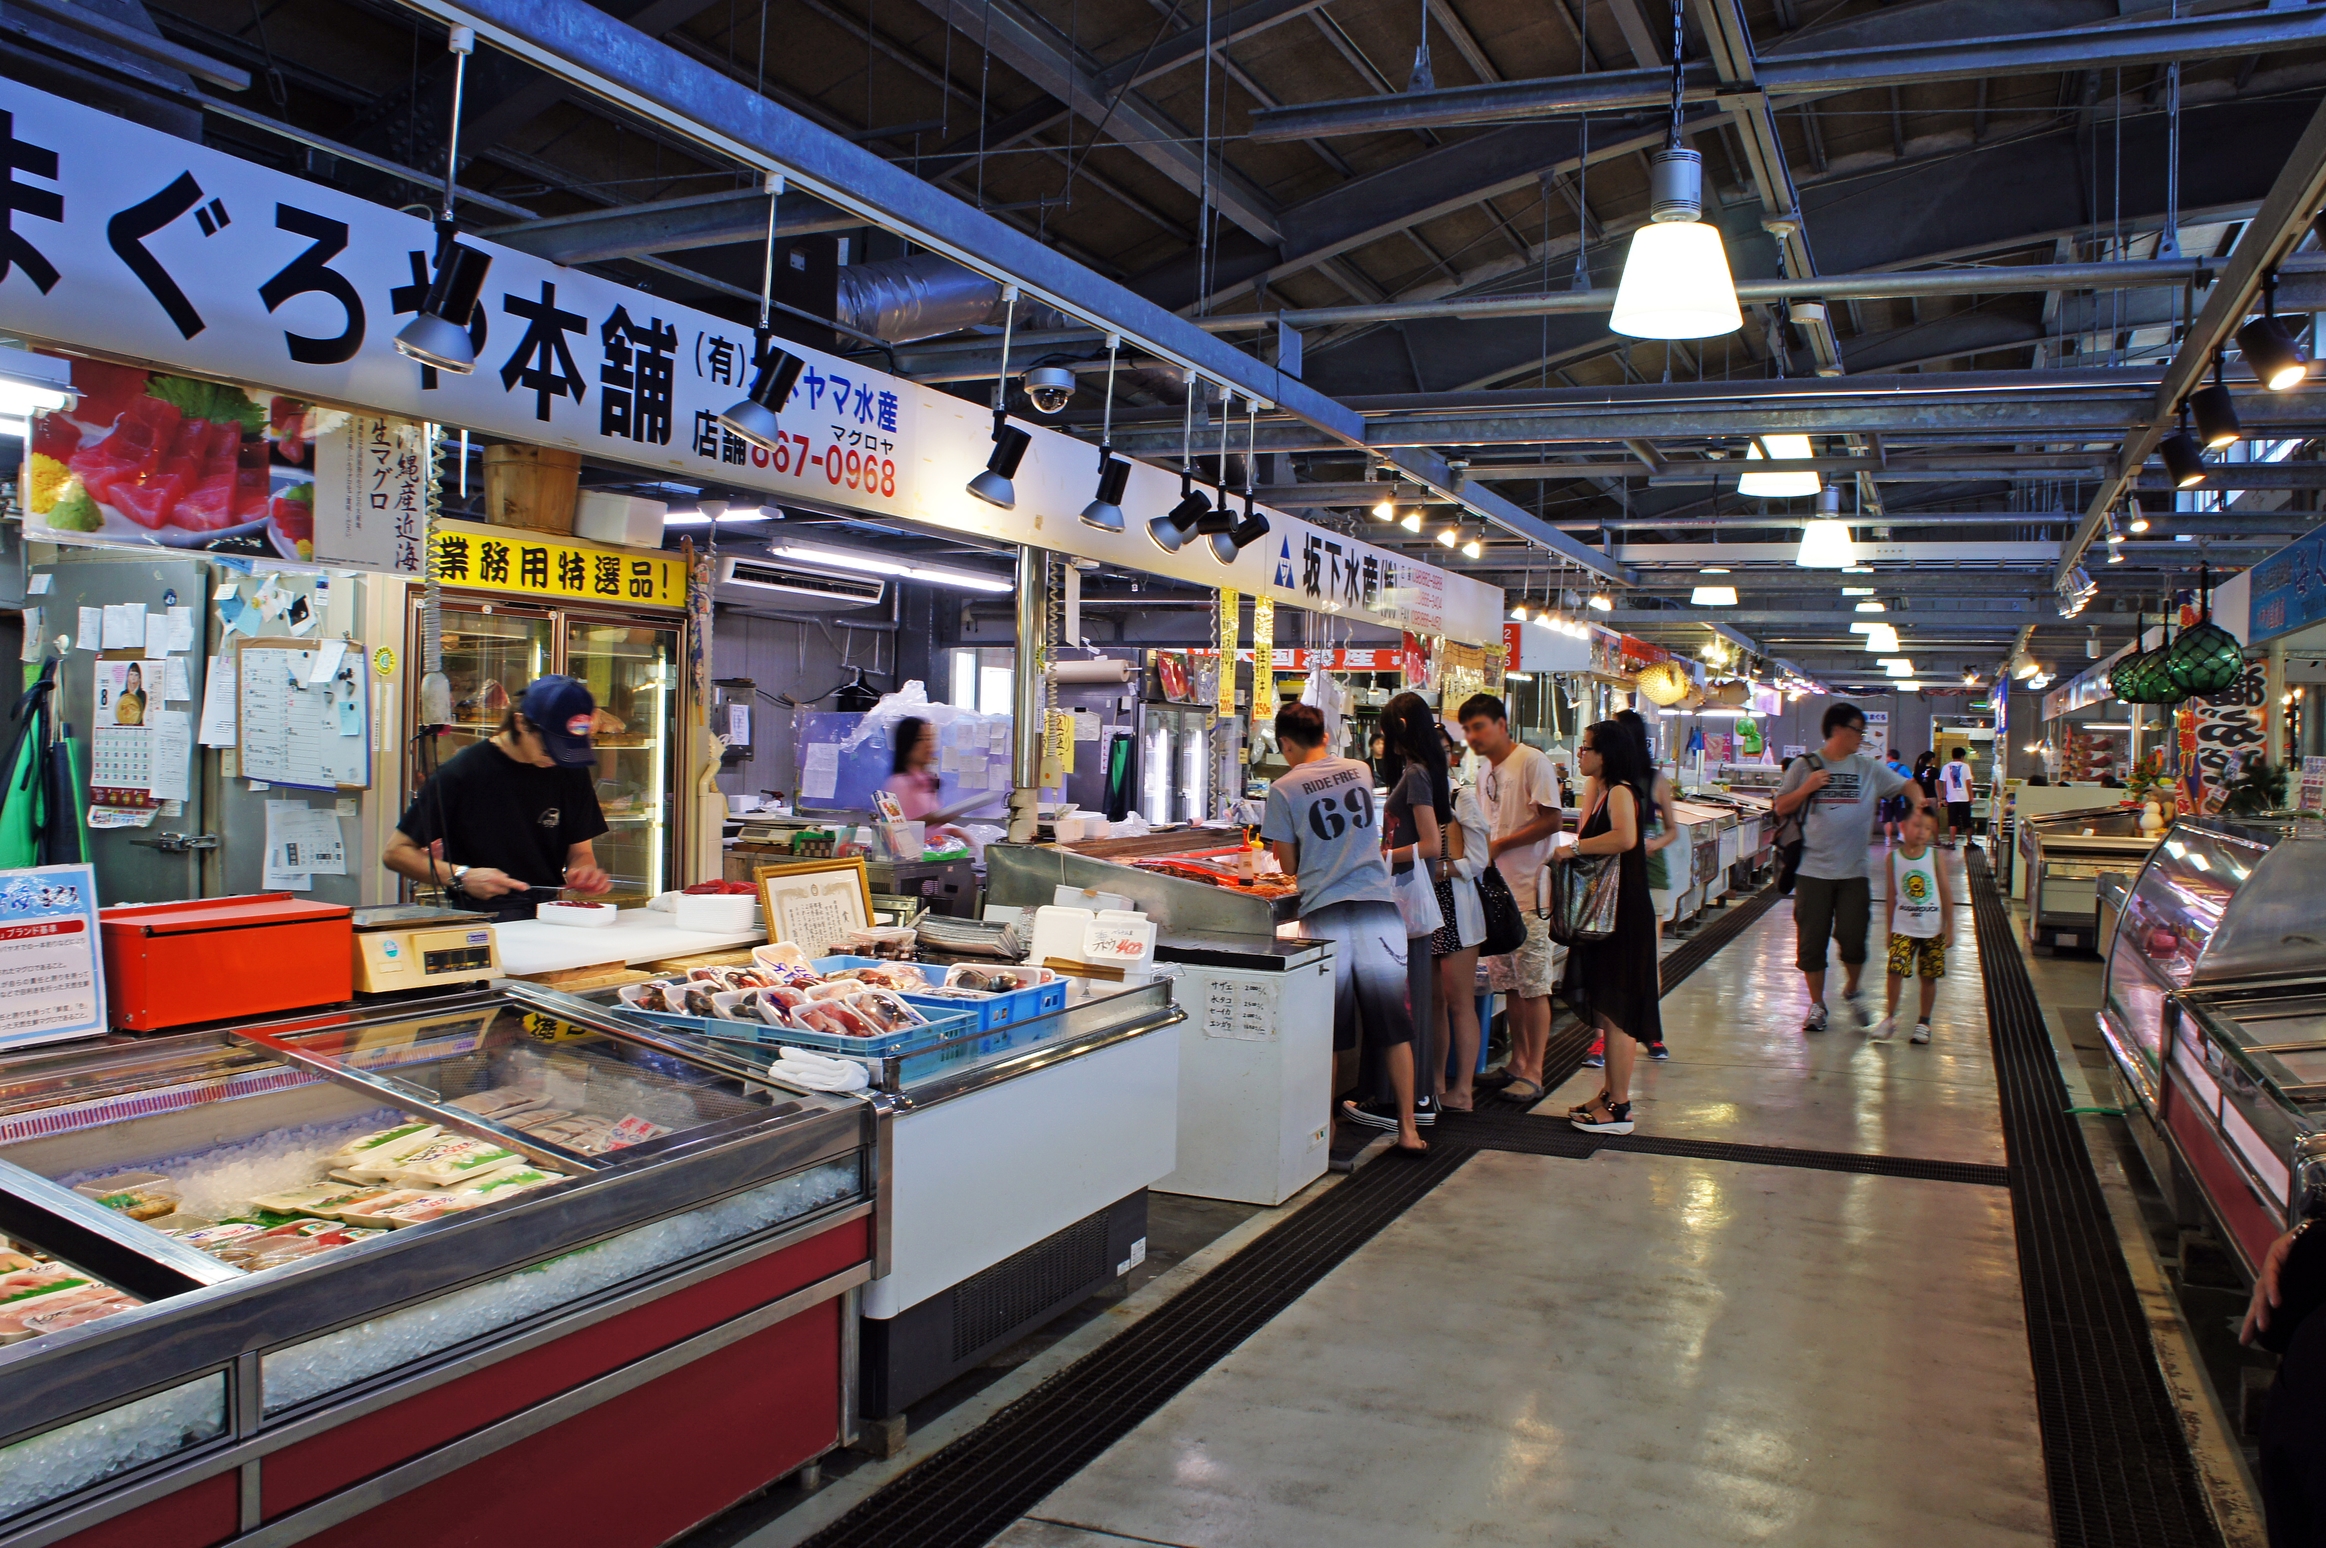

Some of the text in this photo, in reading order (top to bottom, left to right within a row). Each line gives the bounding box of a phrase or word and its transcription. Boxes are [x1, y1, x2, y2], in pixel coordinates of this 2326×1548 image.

[831, 425, 893, 455] マグロヤ
[370, 418, 393, 510] 生マグロ
[439, 534, 669, 600] 業務用特選品!
[1504, 629, 1512, 667] 206
[1302, 768, 1361, 795] RIDE FREE
[1308, 786, 1375, 841] 69
[1210, 981, 1233, 991] サザエ
[1210, 995, 1232, 1004] 水タコ
